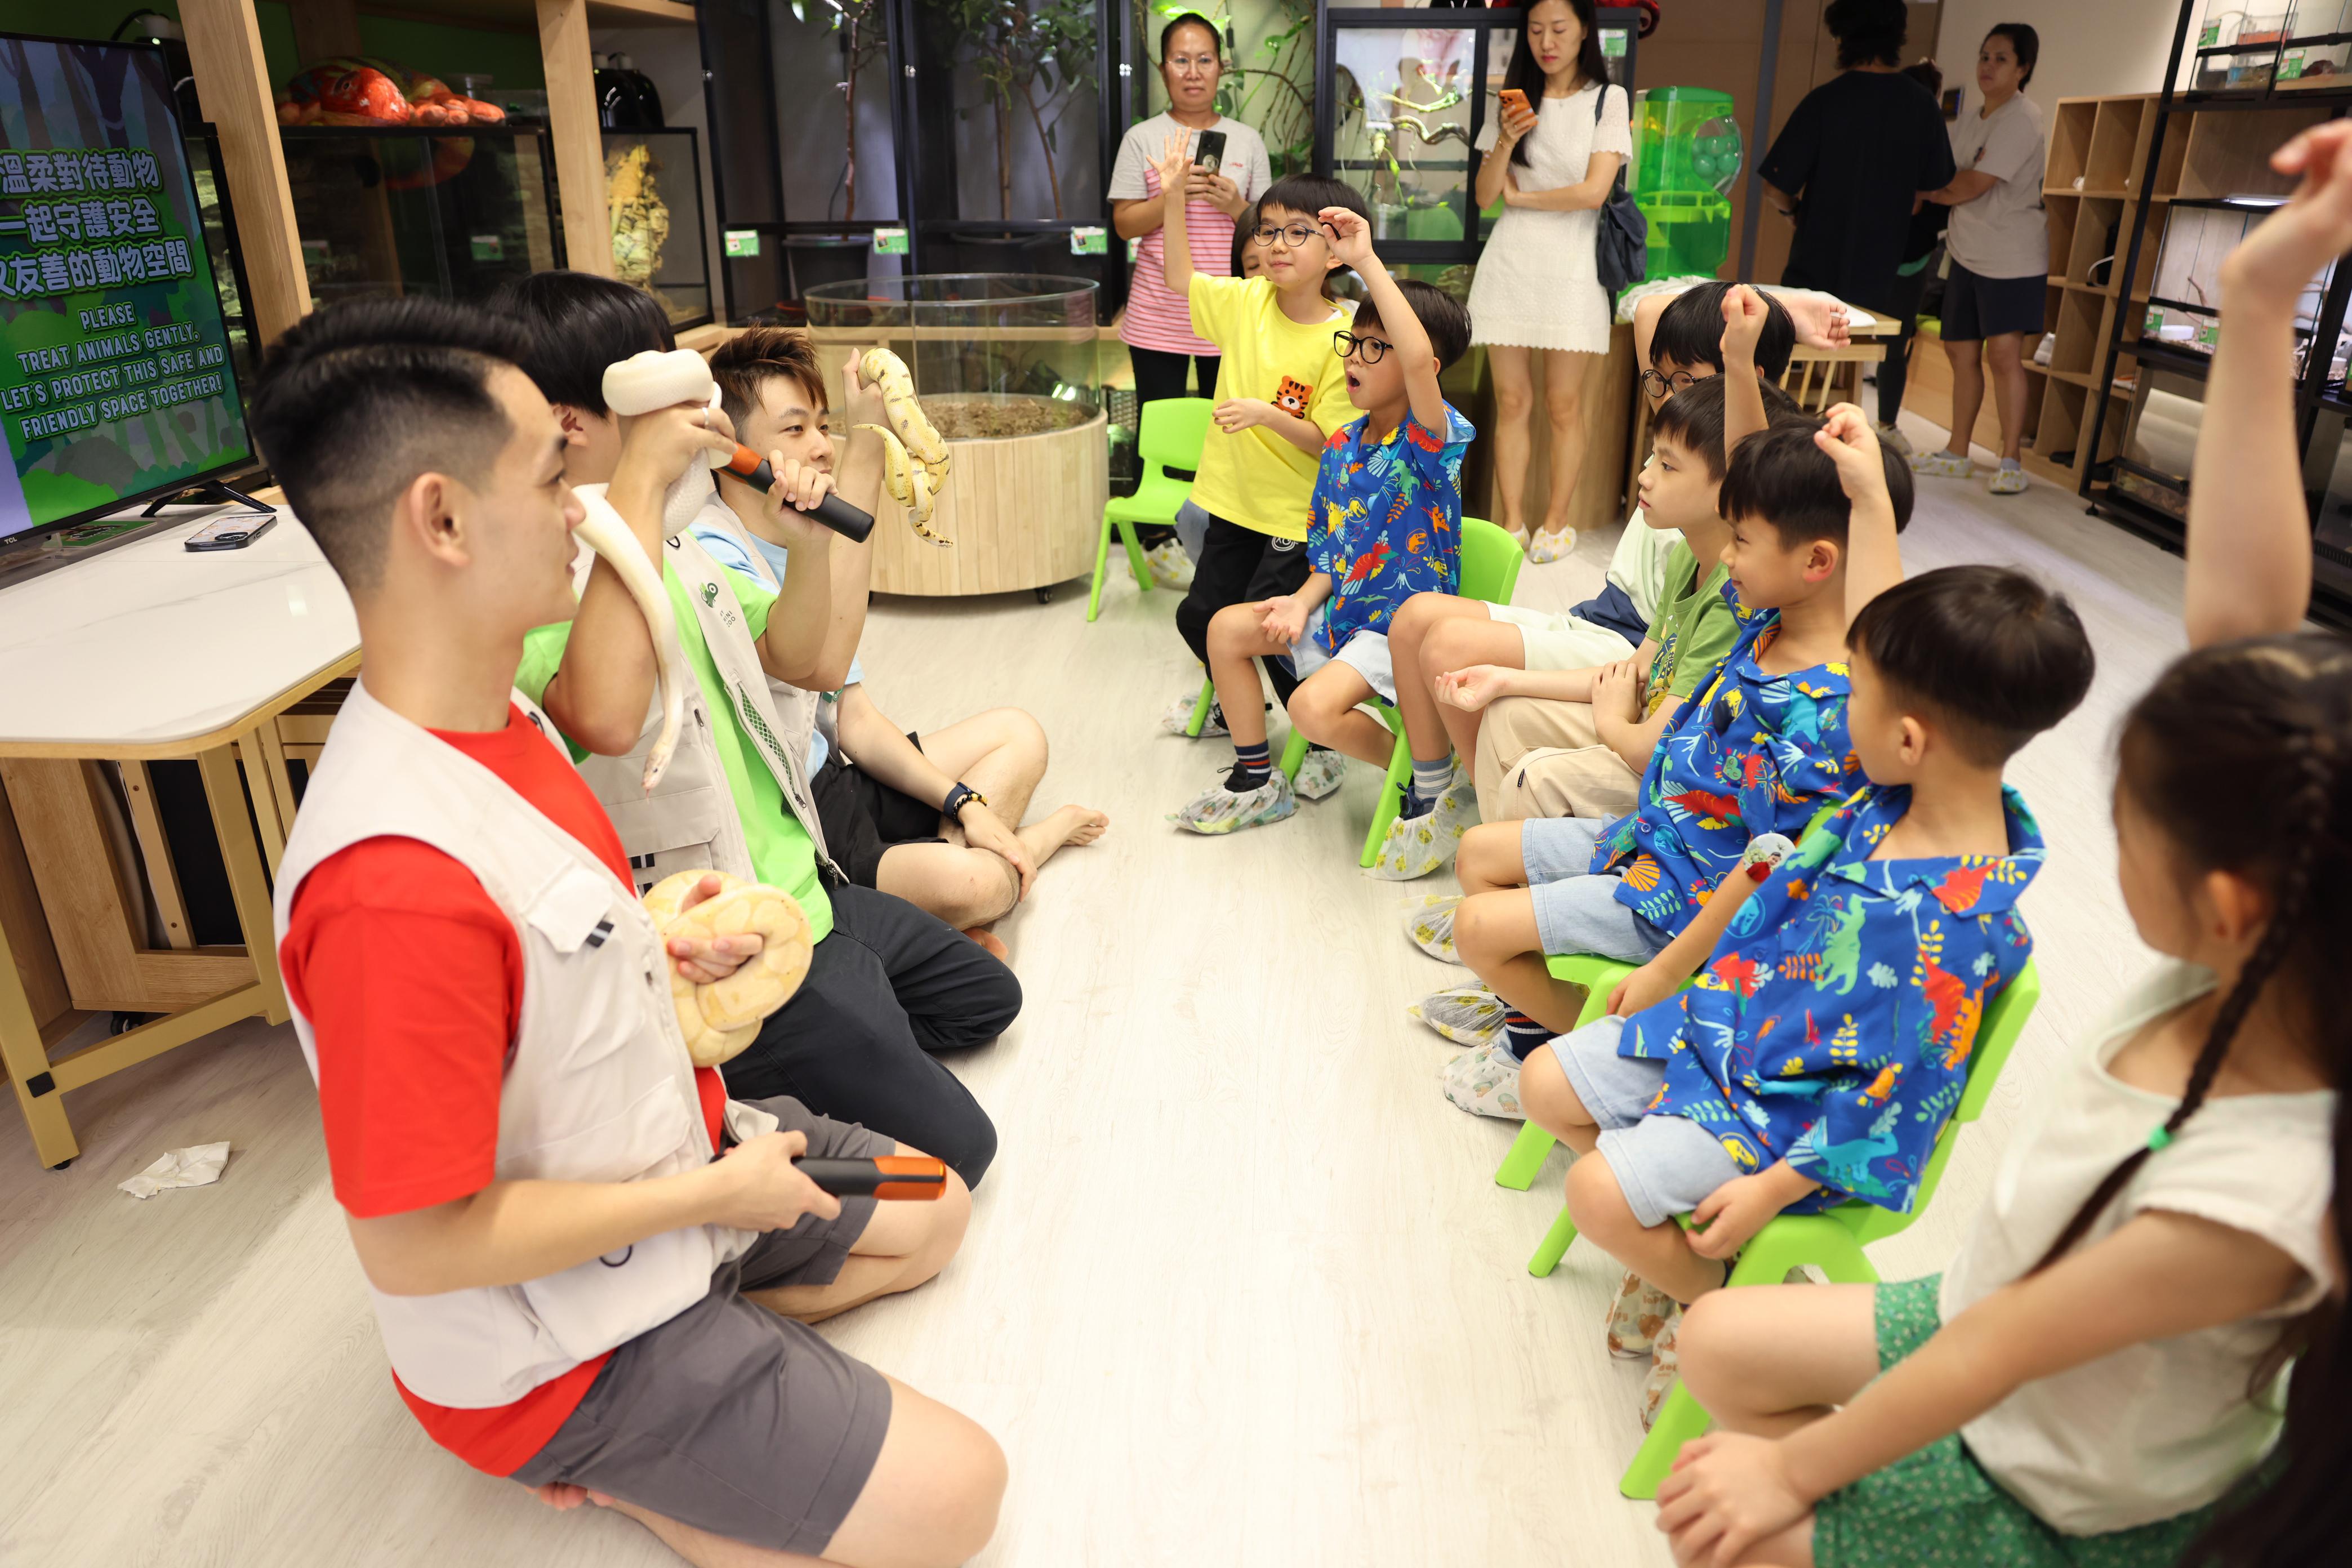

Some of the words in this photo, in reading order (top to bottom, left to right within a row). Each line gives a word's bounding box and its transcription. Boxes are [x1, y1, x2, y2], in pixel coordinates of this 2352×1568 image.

[0, 152, 160, 194] 溫柔對待動物
[0, 198, 160, 243] 一起守護安全
[80, 304, 135, 329] PLEASE
[17, 346, 69, 373] TREAT
[77, 333, 140, 363] ANIMALS
[144, 323, 199, 349] GENTLY.
[1, 384, 47, 411] LET'S
[51, 368, 119, 399] PROTECT
[123, 360, 158, 383] THIS
[161, 352, 194, 376] SAFE
[198, 346, 223, 367] AND
[21, 404, 96, 439] FRIENDLY
[100, 393, 148, 419] SPACE
[150, 374, 222, 407] TOGETHER!
[726, 616, 736, 628] ZOO
